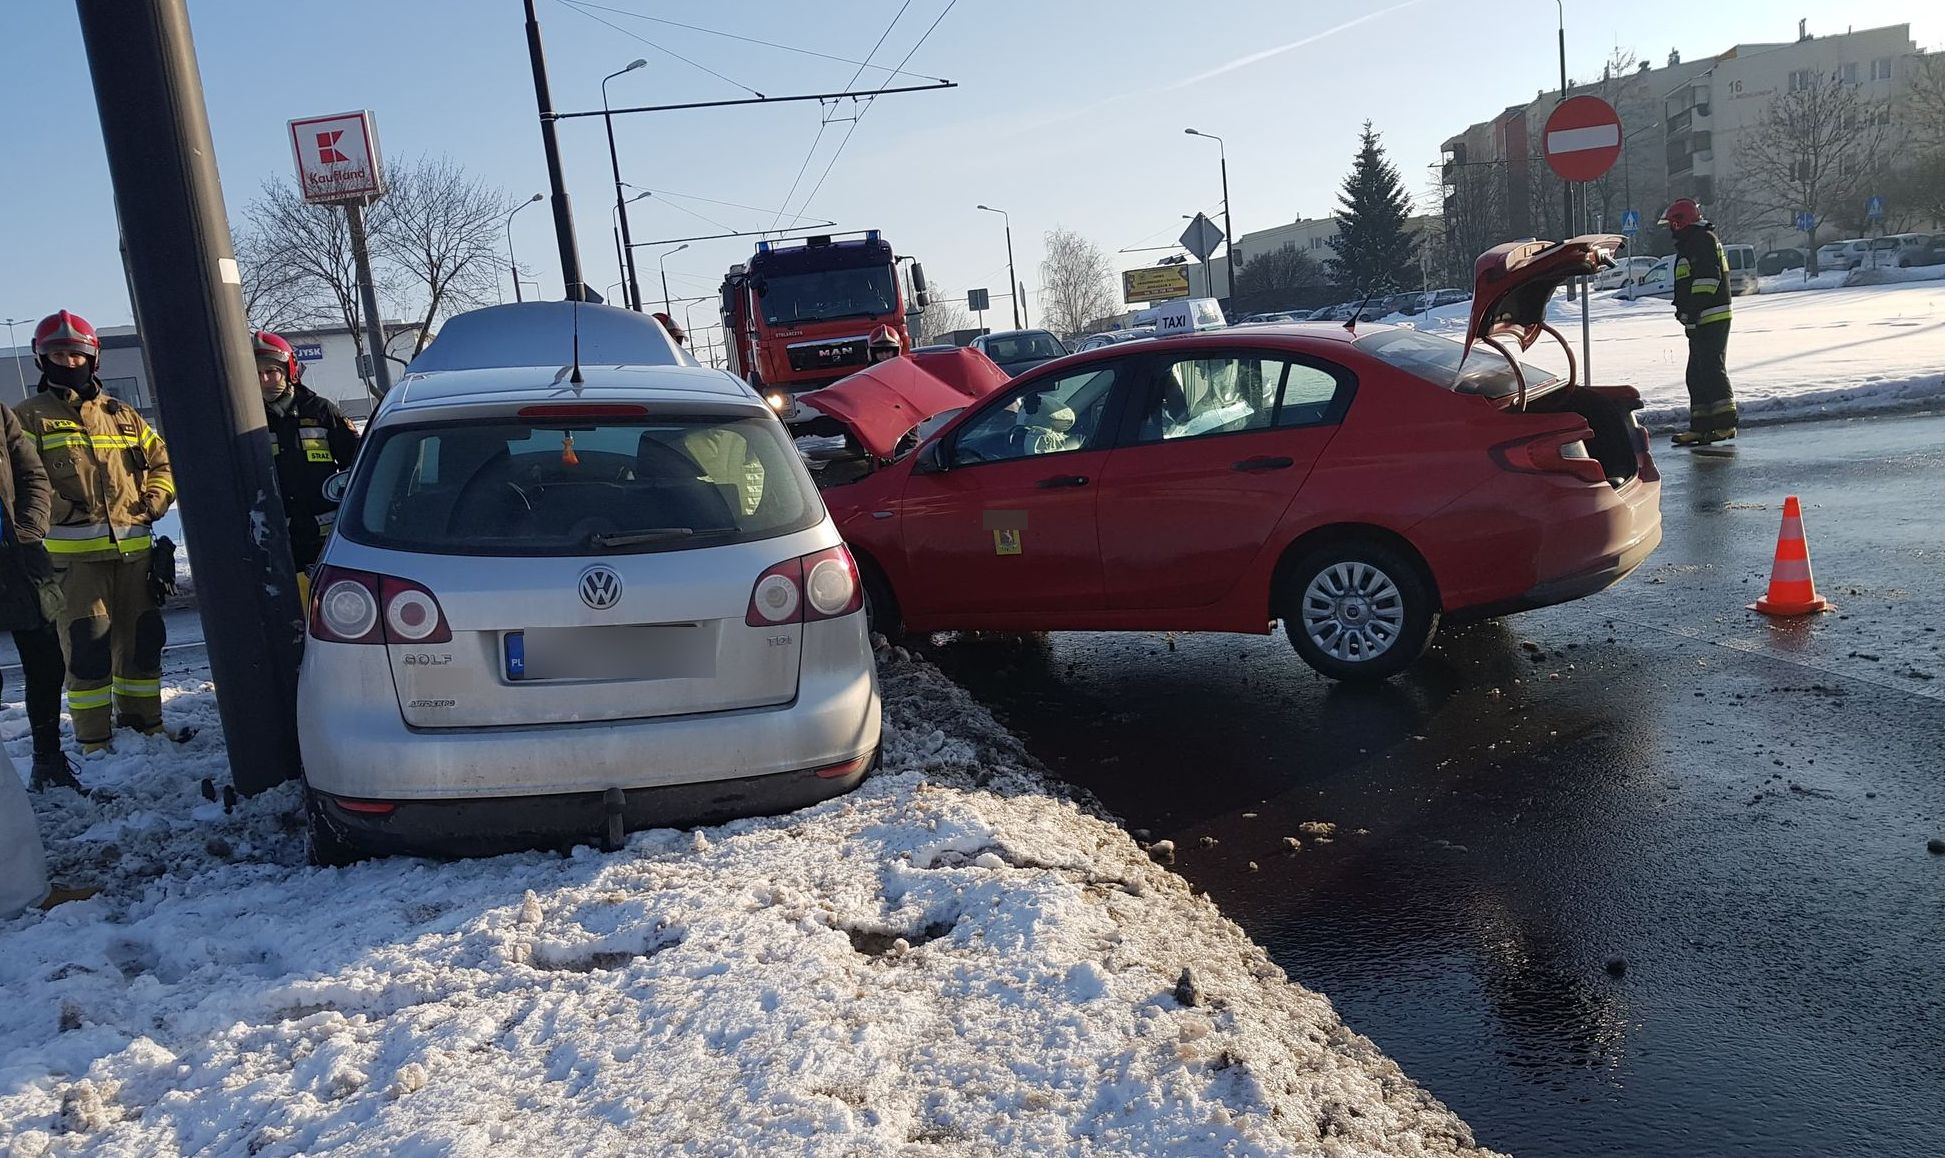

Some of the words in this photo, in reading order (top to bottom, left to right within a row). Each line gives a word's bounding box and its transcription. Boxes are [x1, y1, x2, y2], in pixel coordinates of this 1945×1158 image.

[1729, 80, 1742, 93] 16
[309, 168, 366, 186] Kaufland
[1162, 315, 1186, 329] TAXI
[298, 347, 321, 356] JYSK
[819, 347, 853, 357] MAN
[402, 654, 453, 666] GOLF
[511, 658, 524, 667] PL
